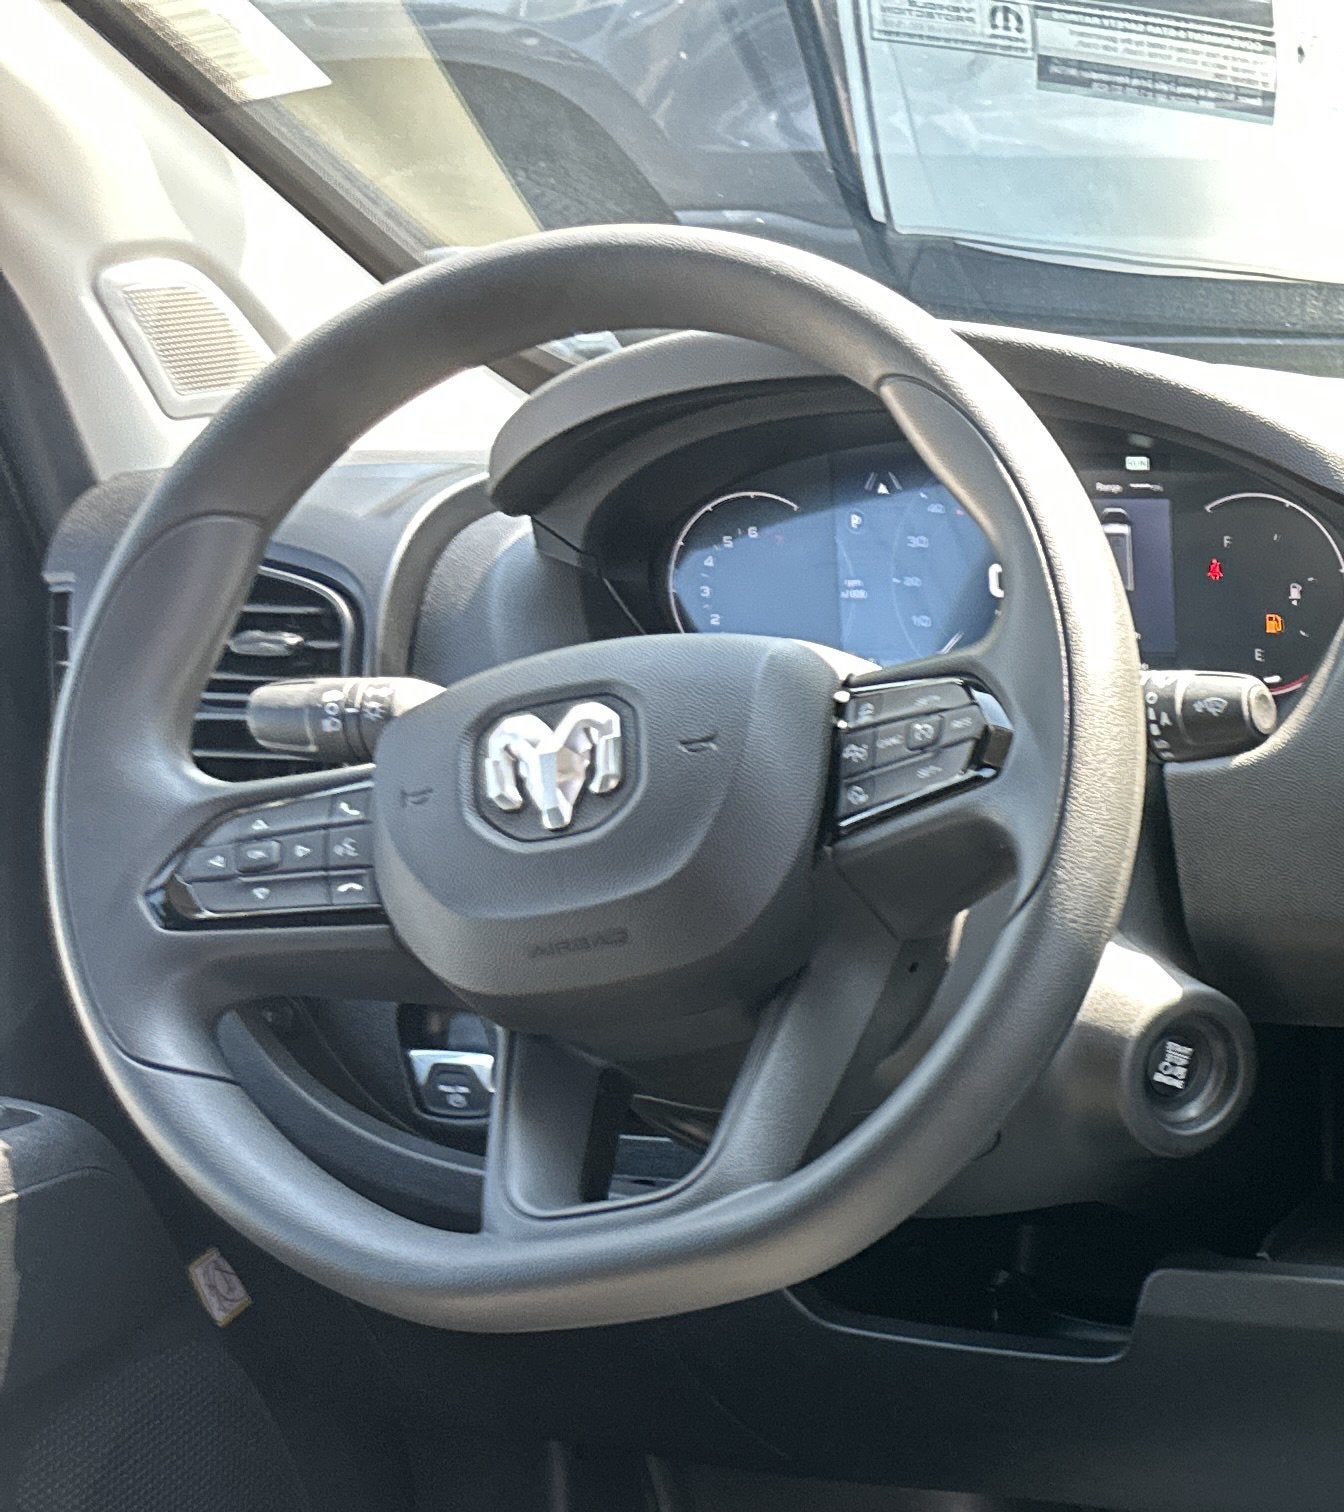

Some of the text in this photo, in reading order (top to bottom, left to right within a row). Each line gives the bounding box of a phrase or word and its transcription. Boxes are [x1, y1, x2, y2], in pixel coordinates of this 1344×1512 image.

[747, 526, 758, 538] 6
[722, 535, 733, 548] 5
[1224, 536, 1232, 548] F
[704, 556, 714, 567] 4
[700, 586, 710, 597] 3
[710, 614, 720, 625] 2
[1255, 649, 1265, 661] E
